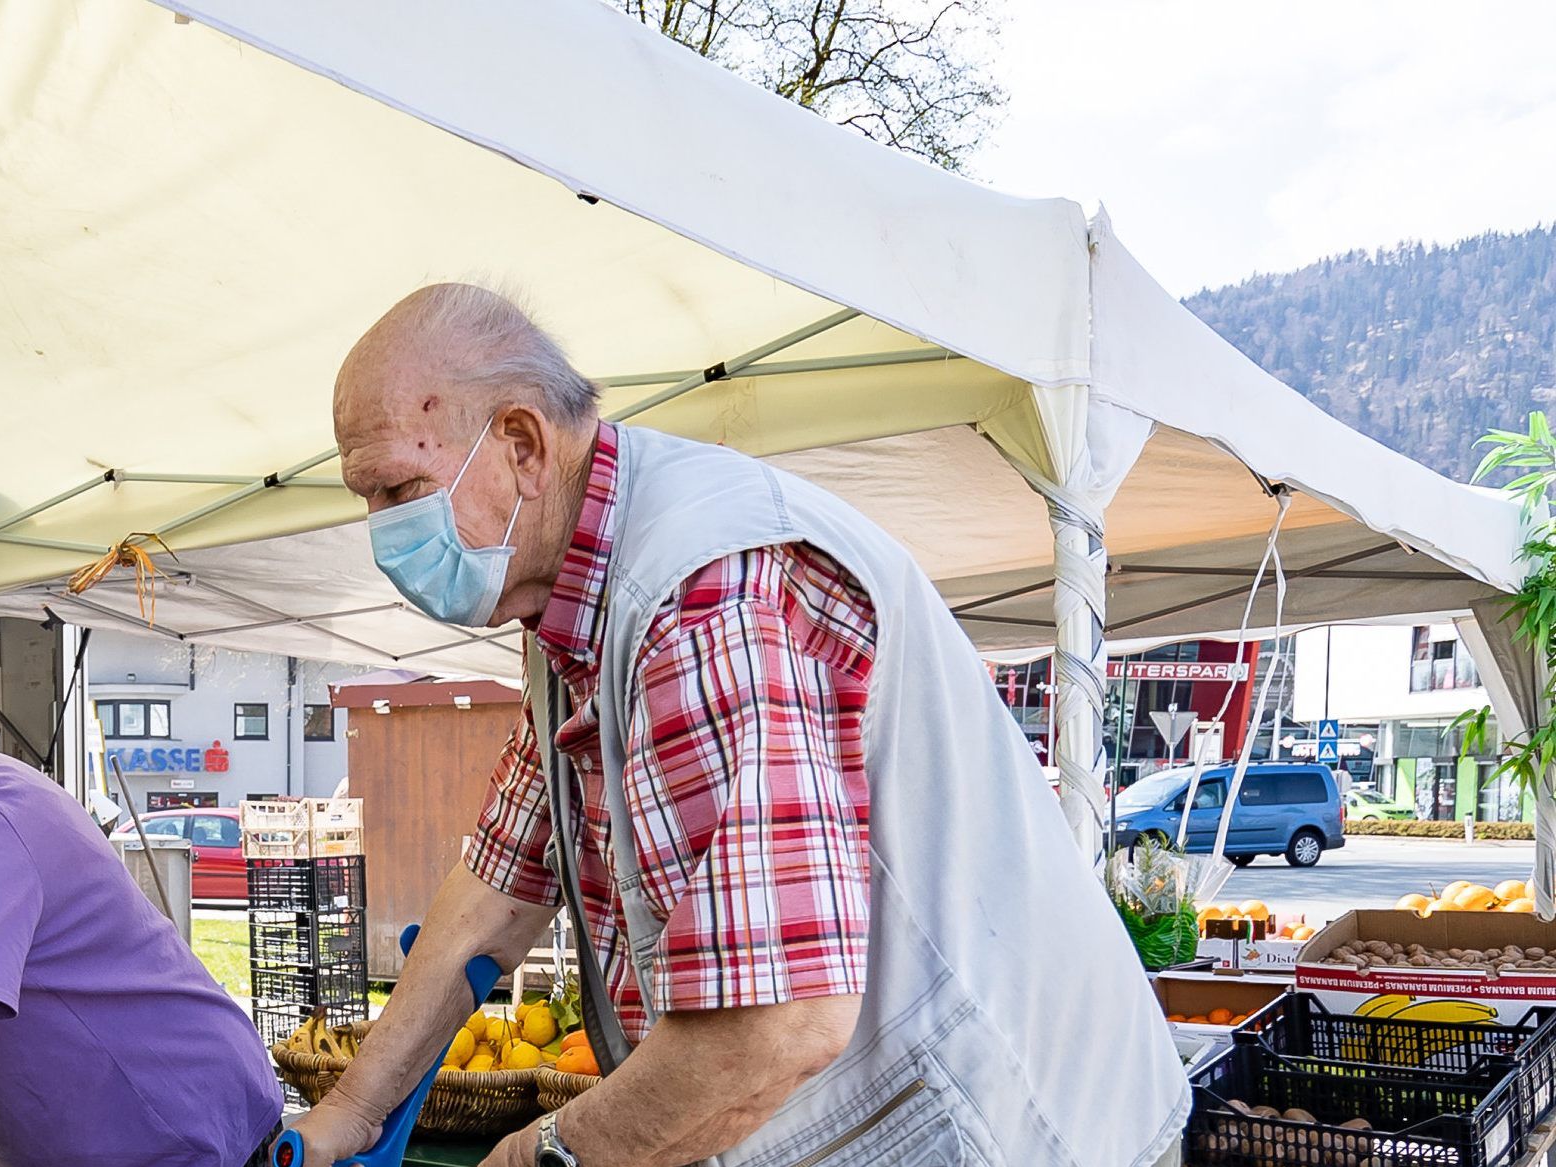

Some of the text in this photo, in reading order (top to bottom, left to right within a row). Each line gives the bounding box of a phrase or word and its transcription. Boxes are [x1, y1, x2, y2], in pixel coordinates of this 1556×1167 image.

[1114, 664, 1228, 678] INTERSPAR
[89, 748, 201, 772] KASSE
[1299, 975, 1339, 988] BANANAS
[1385, 981, 1428, 992] BANANAS
[1429, 983, 1472, 994] PREMIUM
[1479, 984, 1525, 995] BANANAS
[1527, 986, 1556, 996] MIUM
